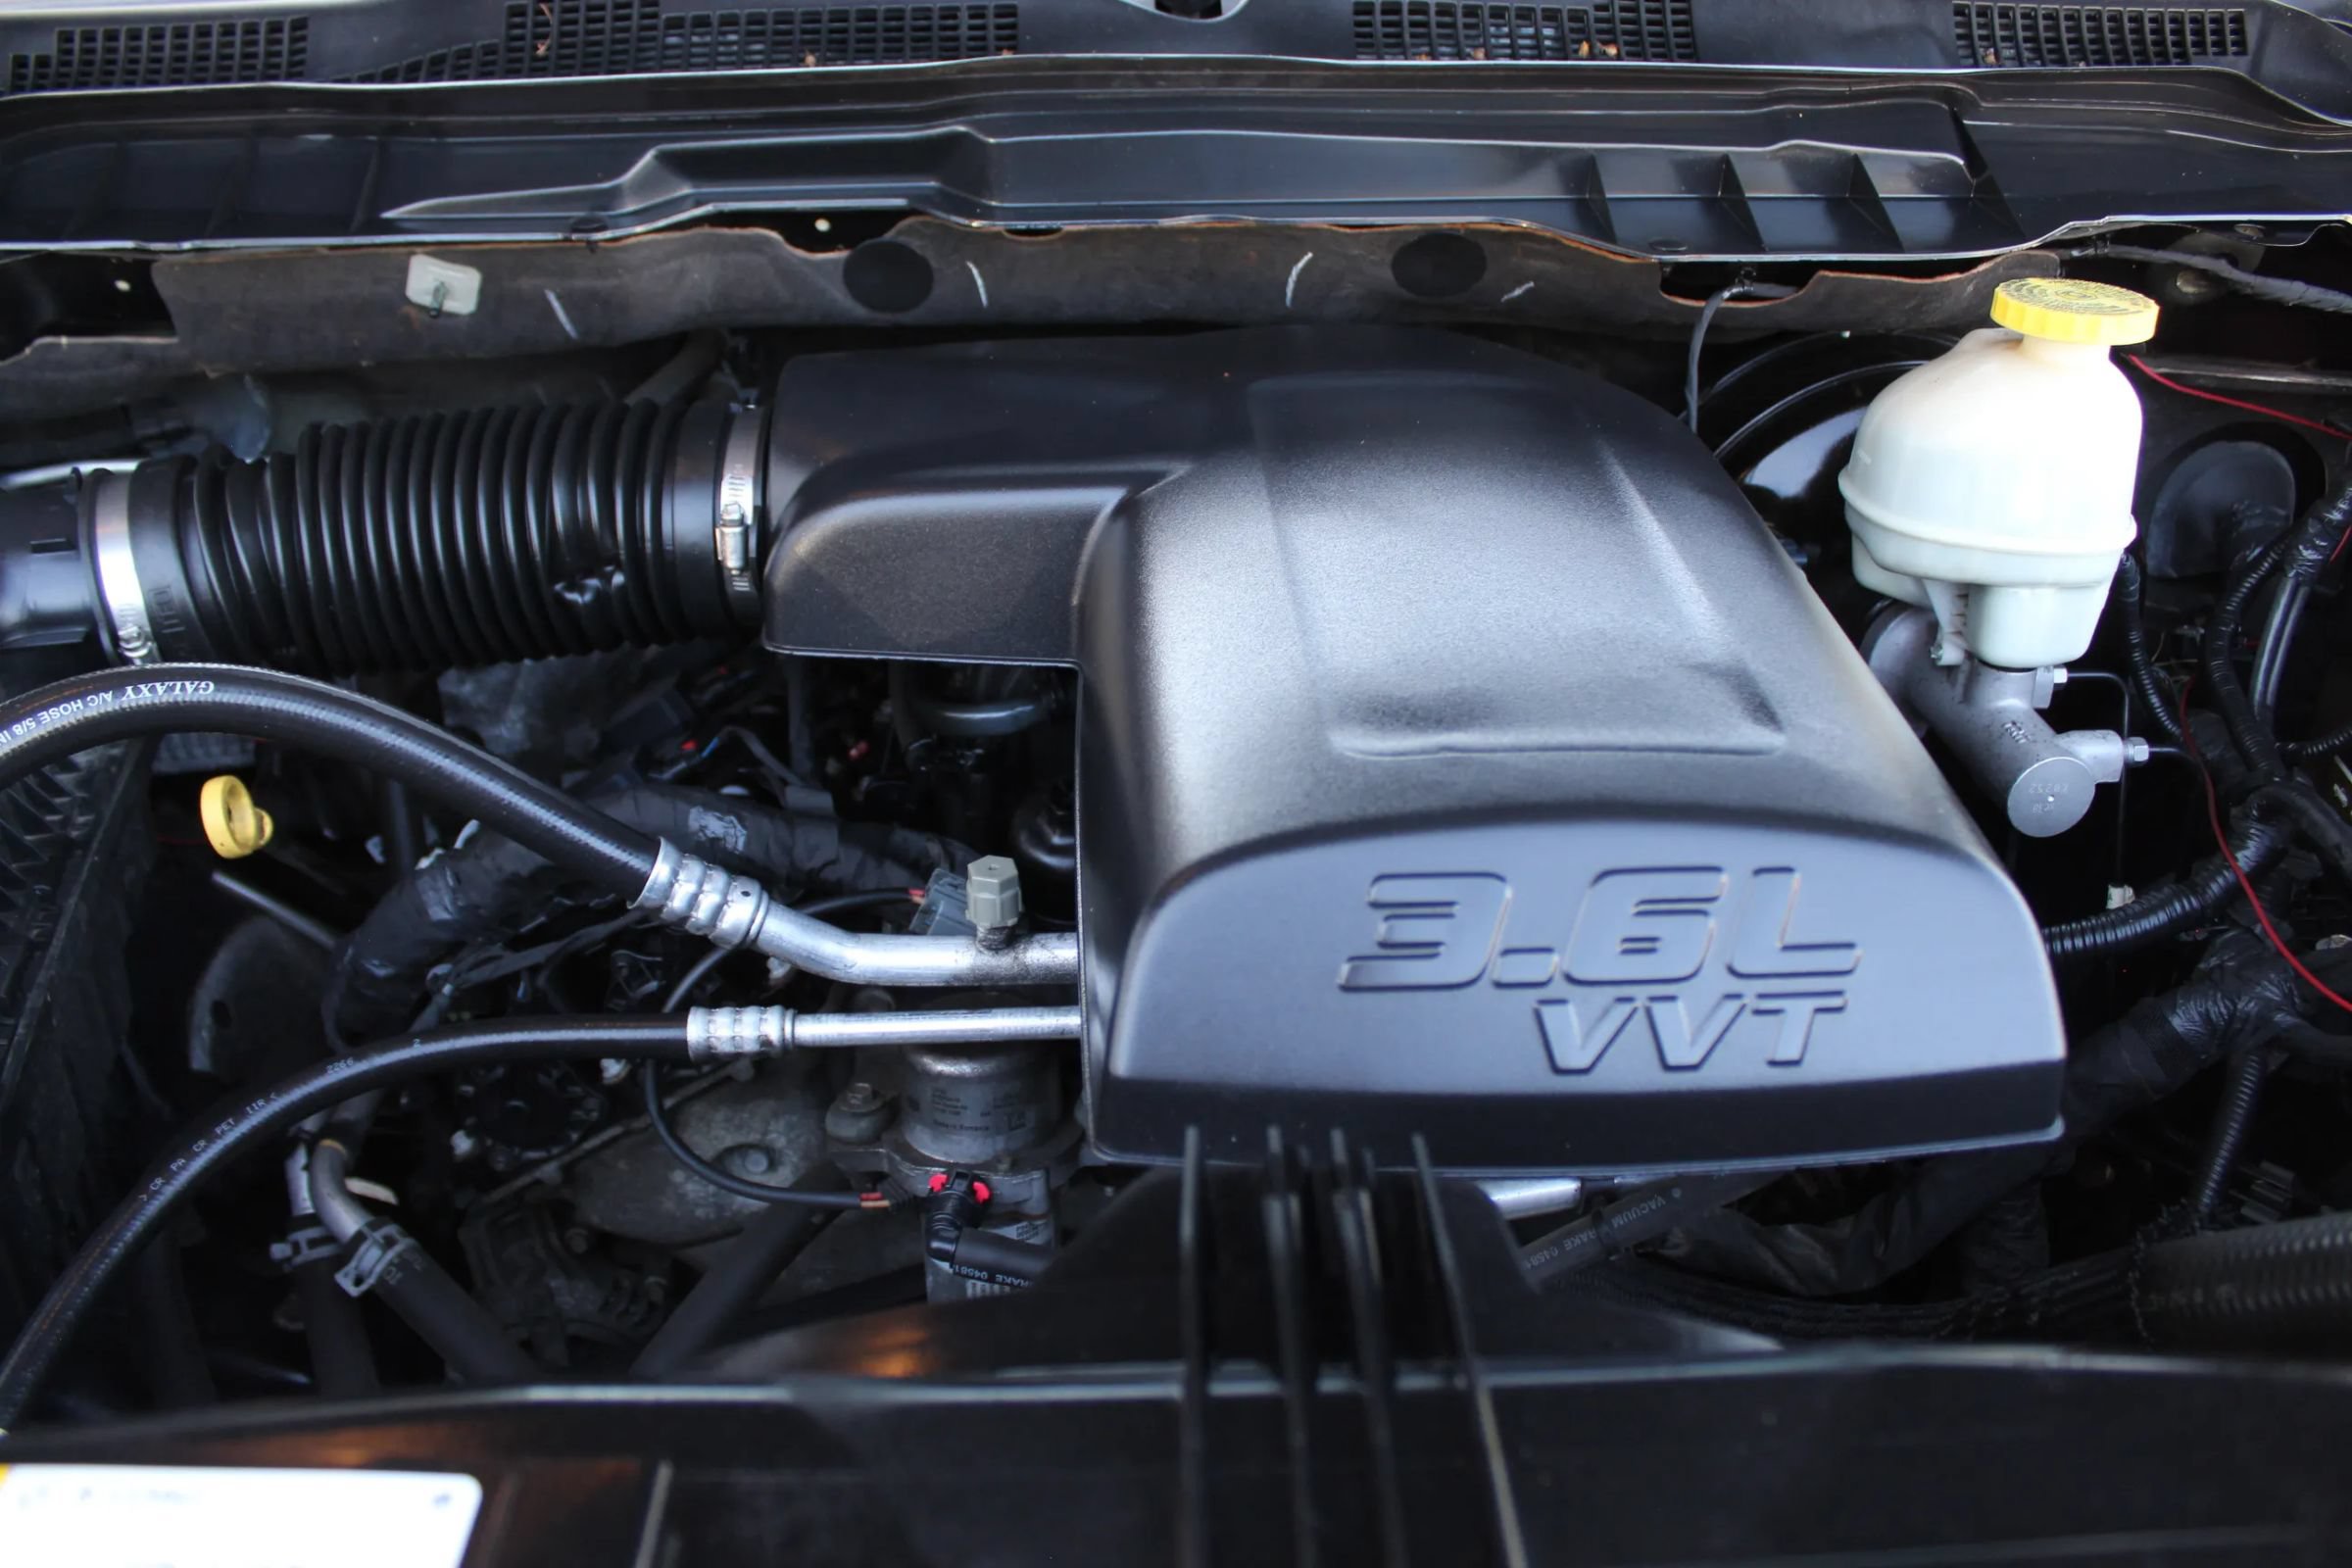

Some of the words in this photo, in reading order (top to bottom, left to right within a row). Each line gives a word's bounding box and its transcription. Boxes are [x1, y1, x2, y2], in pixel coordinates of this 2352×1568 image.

[86, 690, 113, 706] A/C
[123, 680, 215, 699] GALAXY
[37, 699, 84, 724] HOSE
[12, 717, 36, 736] 5/8
[1338, 865, 1863, 993] 3.6L
[1532, 990, 1848, 1075] VVT
[149, 1176, 166, 1192] CR
[170, 1157, 186, 1172] PA
[192, 1139, 208, 1152] CR
[215, 1117, 235, 1136] PET
[1611, 1194, 1666, 1229] VACUUM
[1564, 1229, 1596, 1251] RAKE
